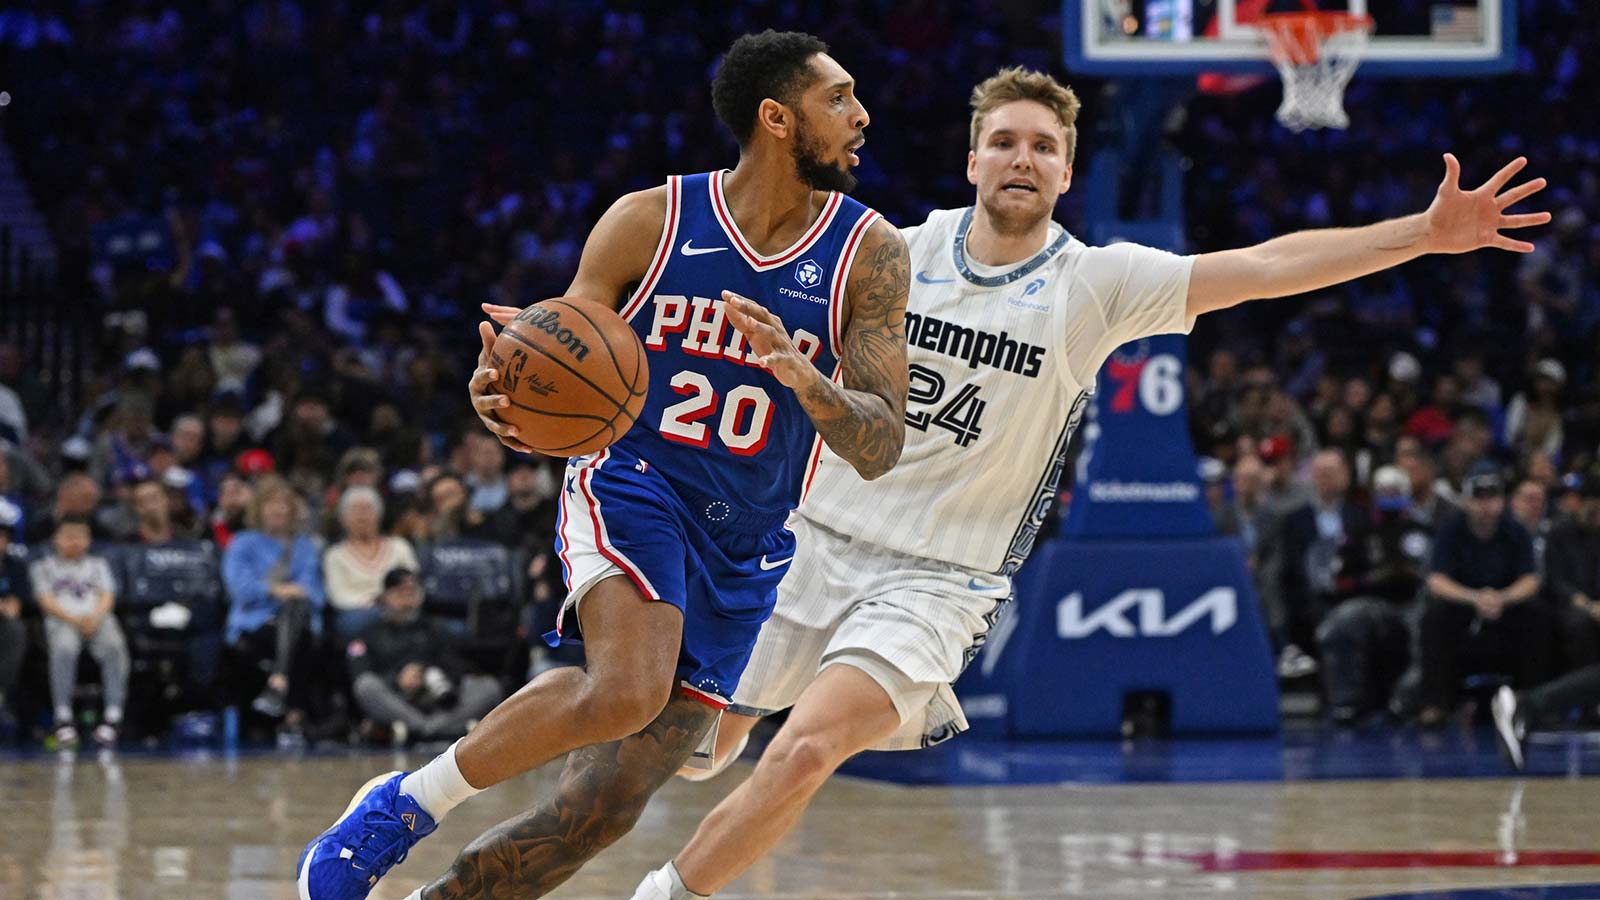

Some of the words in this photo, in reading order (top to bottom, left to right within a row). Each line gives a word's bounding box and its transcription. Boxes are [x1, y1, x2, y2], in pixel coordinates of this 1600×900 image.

[779, 286, 828, 306] crypto.com
[659, 370, 775, 457] 20
[904, 363, 987, 448] 24
[1108, 354, 1184, 416] 76
[1056, 586, 1237, 638] KIA
